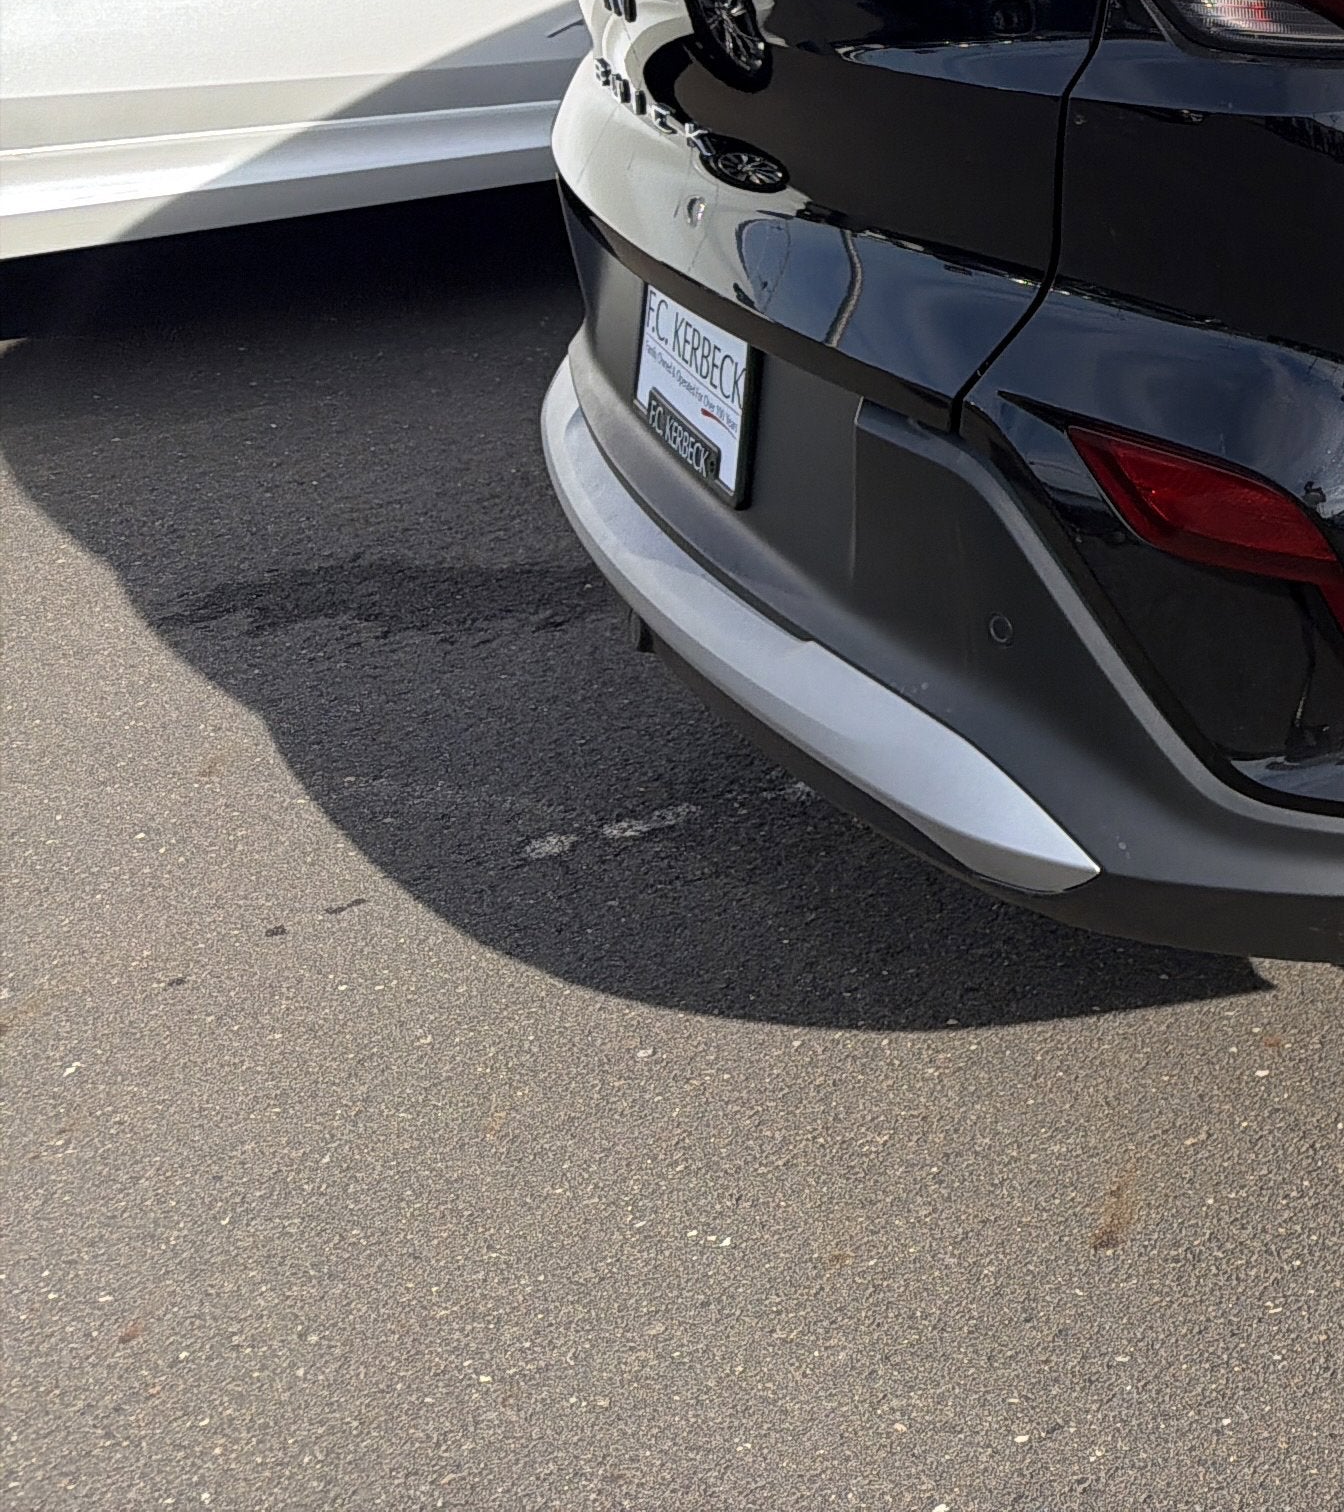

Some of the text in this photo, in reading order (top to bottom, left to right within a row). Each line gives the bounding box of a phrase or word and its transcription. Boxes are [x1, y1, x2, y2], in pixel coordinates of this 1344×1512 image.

[594, 58, 713, 156] BUICK
[646, 290, 747, 410] F.C. KERBECK
[665, 415, 709, 478] KERBECK
